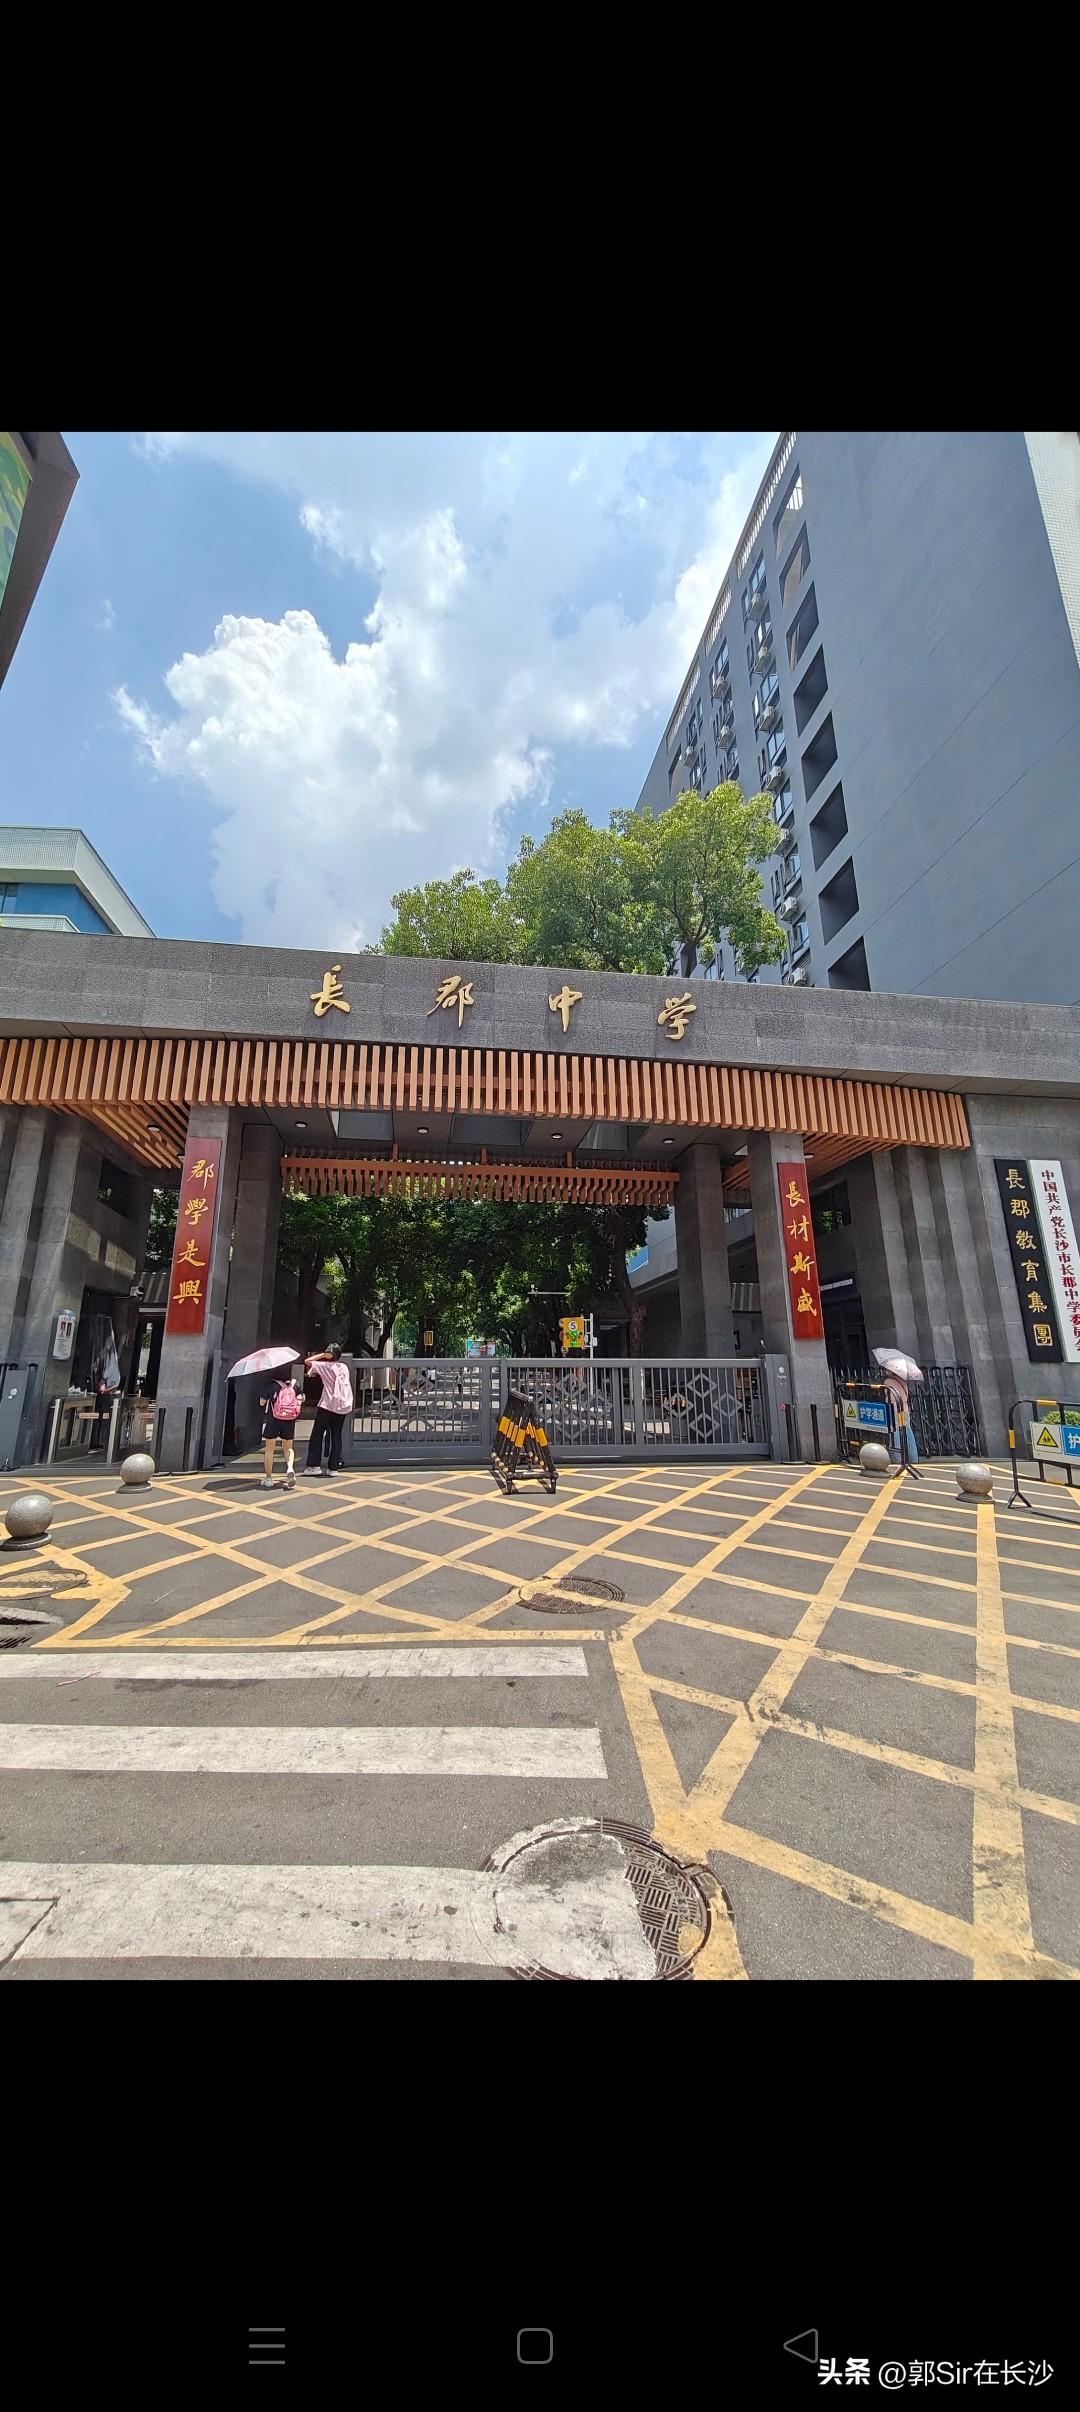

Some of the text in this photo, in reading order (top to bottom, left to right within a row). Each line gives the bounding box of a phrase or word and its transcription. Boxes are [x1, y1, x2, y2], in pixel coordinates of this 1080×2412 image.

[172, 1159, 215, 1305] 郡學是興
[785, 1181, 817, 1317] 長材斯盛
